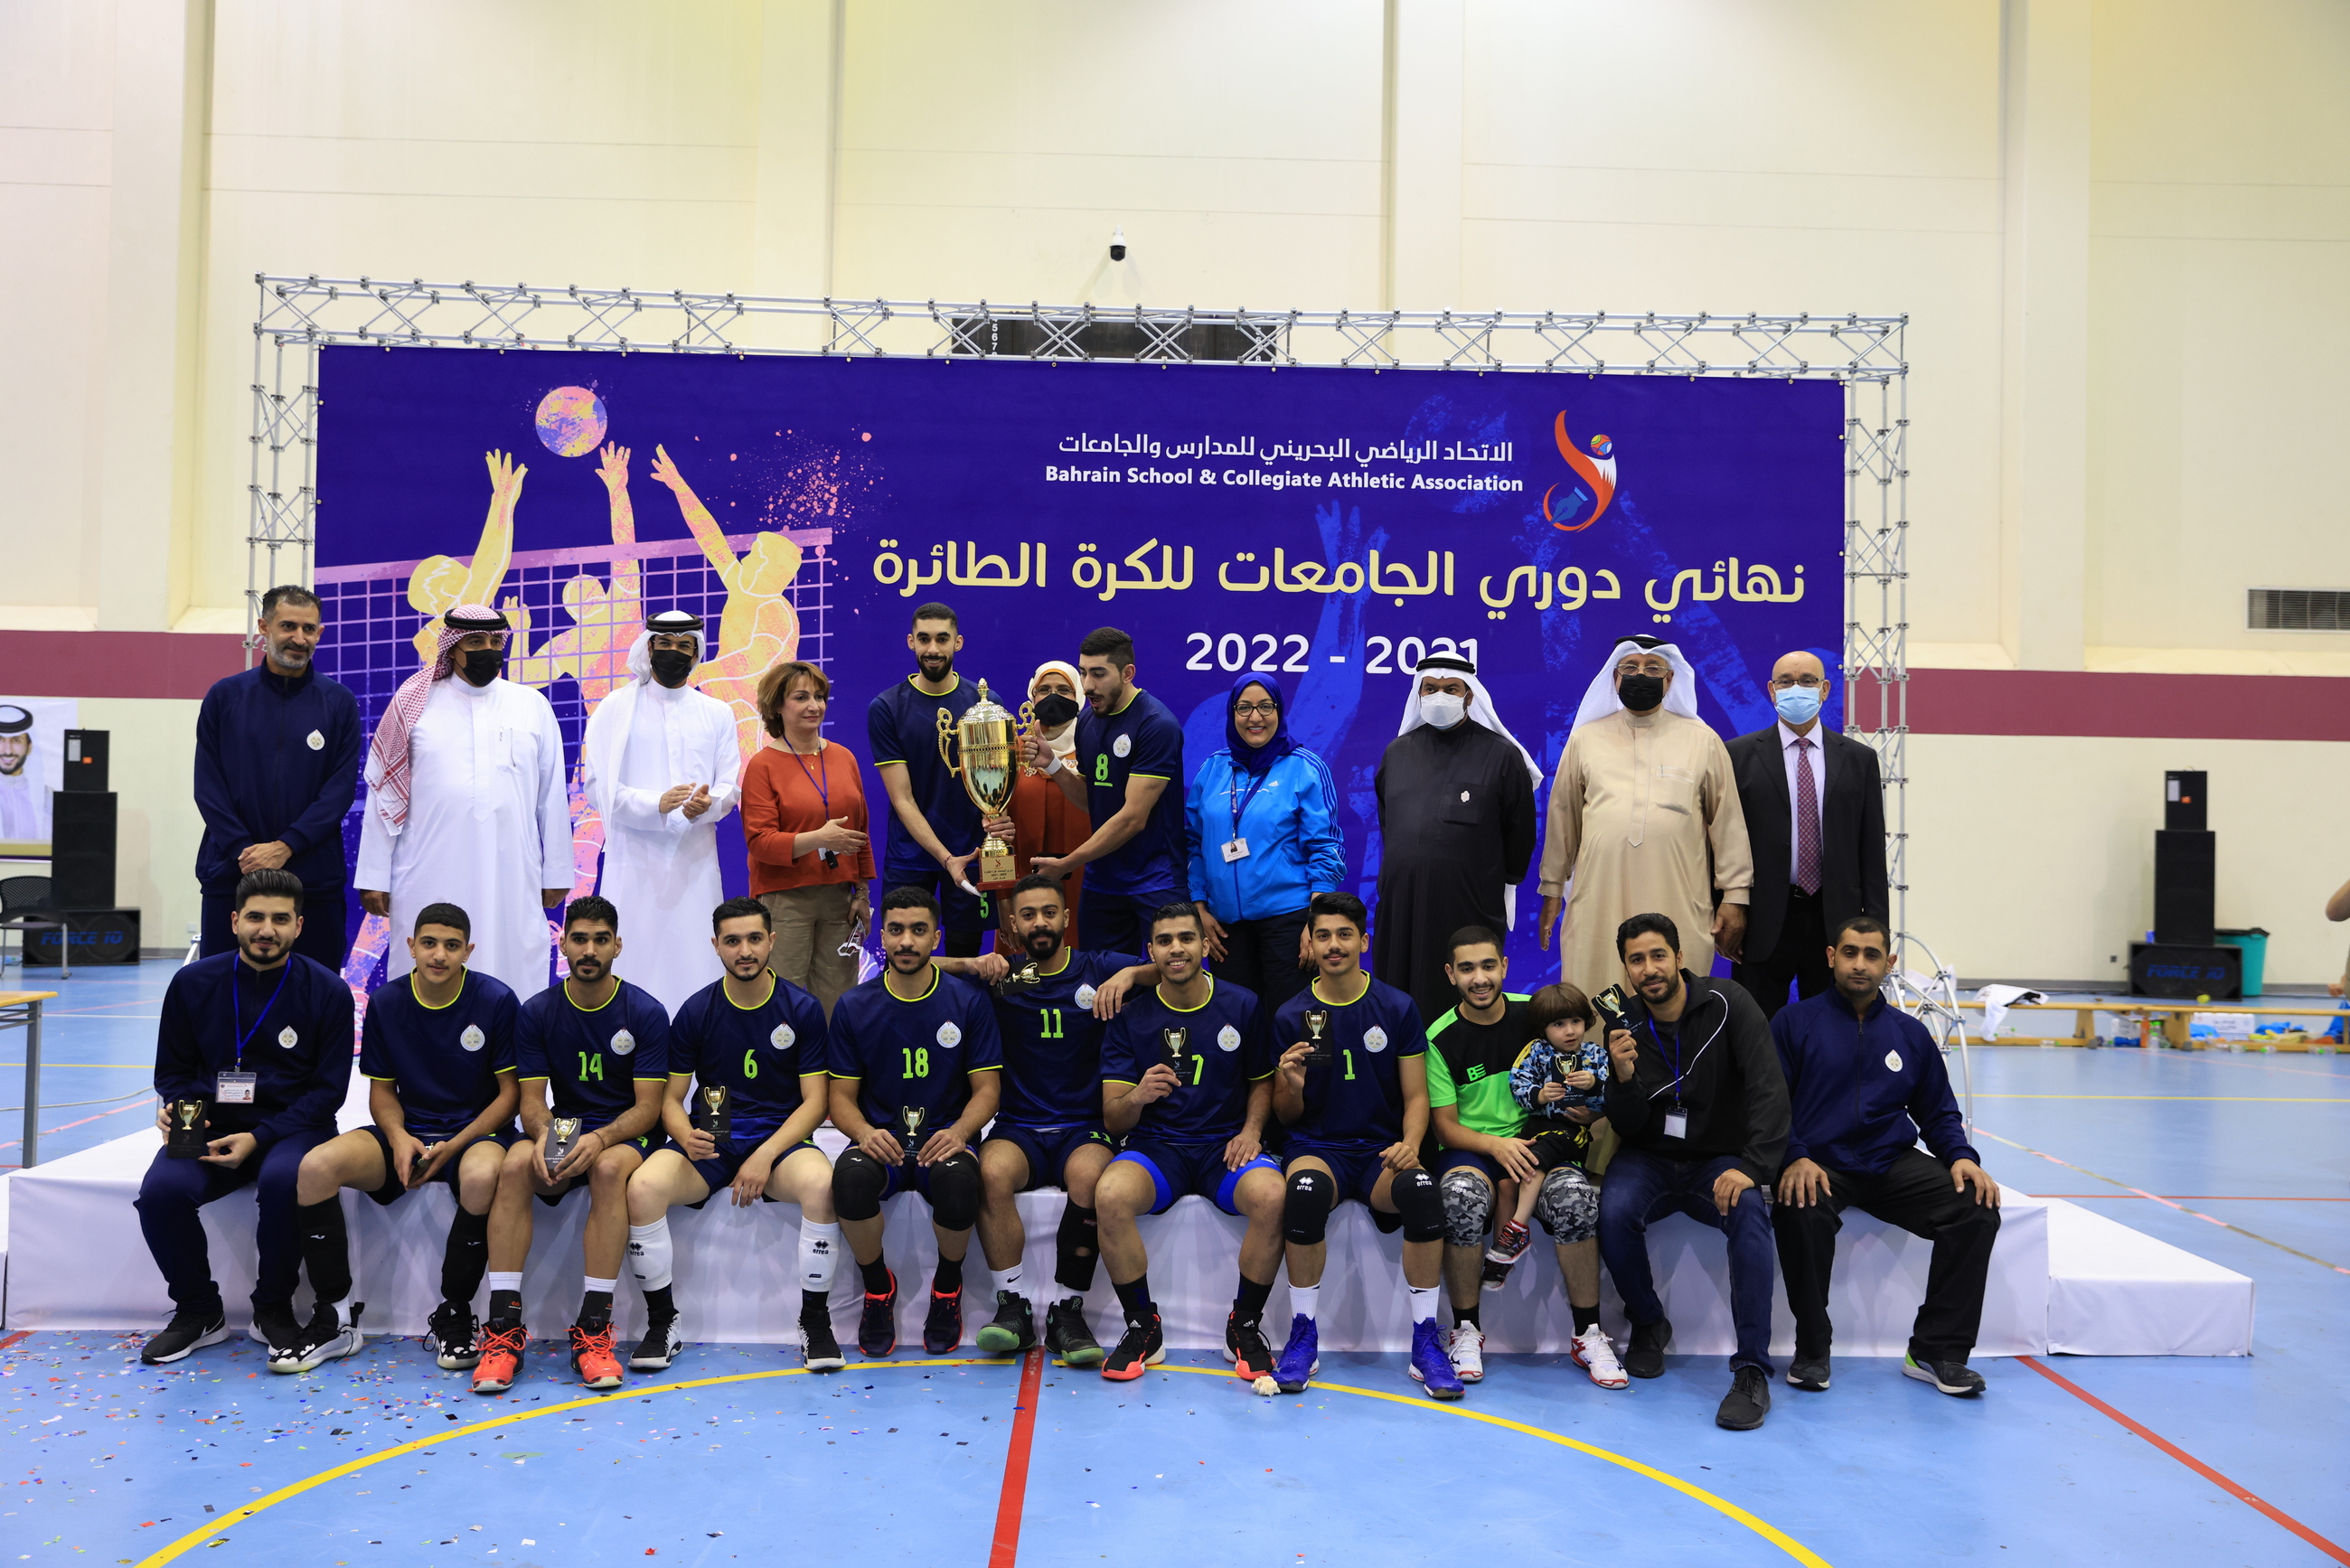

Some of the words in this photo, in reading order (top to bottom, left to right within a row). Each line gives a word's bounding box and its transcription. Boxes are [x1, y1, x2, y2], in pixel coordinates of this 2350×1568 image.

[992, 324, 998, 332] 5
[992, 333, 998, 342] 6
[992, 343, 998, 351] 7
[1058, 432, 1161, 458] والجامعات
[1165, 435, 1255, 459] للمدارس
[1260, 437, 1350, 466] البحريني
[1355, 439, 1437, 468] الرياضي
[1443, 440, 1513, 462] الاتحاد
[1045, 465, 1121, 483] Bahrain
[1127, 467, 1193, 484] School
[1198, 468, 1217, 485] &
[1222, 469, 1322, 491] Collegiate
[1327, 472, 1405, 489] Athletic
[1411, 474, 1524, 492] Association
[872, 539, 1047, 597] الطائرة
[1071, 538, 1194, 601] للكرة
[1217, 547, 1454, 607] الجامعات
[1479, 565, 1622, 620] دوري
[1643, 556, 1806, 624] نهائي
[1185, 632, 1310, 672] 2022
[1330, 655, 1346, 663] -
[1095, 753, 1108, 781] 8
[980, 892, 990, 919] 5
[1040, 1009, 1064, 1038] 11
[578, 1051, 604, 1082] 14
[744, 1049, 758, 1079] 6
[902, 1047, 929, 1079] 18
[1192, 1054, 1204, 1085] 7
[1343, 1049, 1356, 1080] 1
[1416, 1178, 1433, 1187] errea
